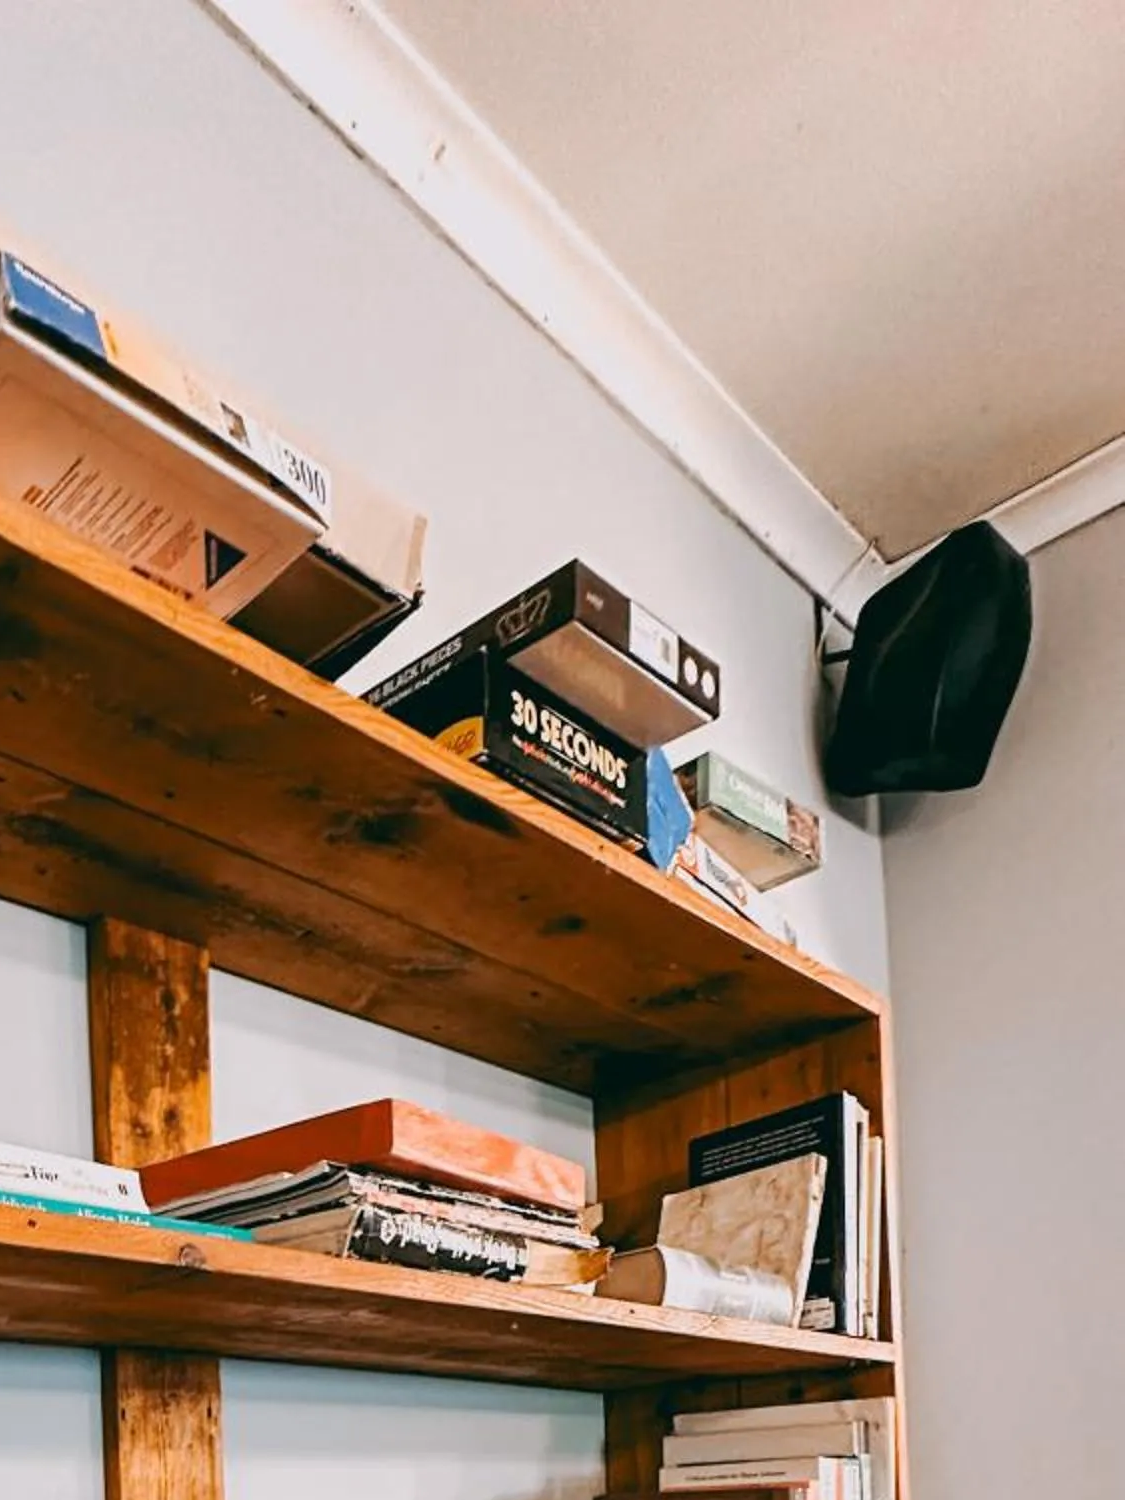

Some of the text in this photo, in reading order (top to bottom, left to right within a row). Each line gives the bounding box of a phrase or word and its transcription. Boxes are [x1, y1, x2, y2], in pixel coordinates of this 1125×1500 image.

[283, 448, 326, 506] 300
[510, 689, 537, 735] 30
[540, 709, 629, 789] SECONDS
